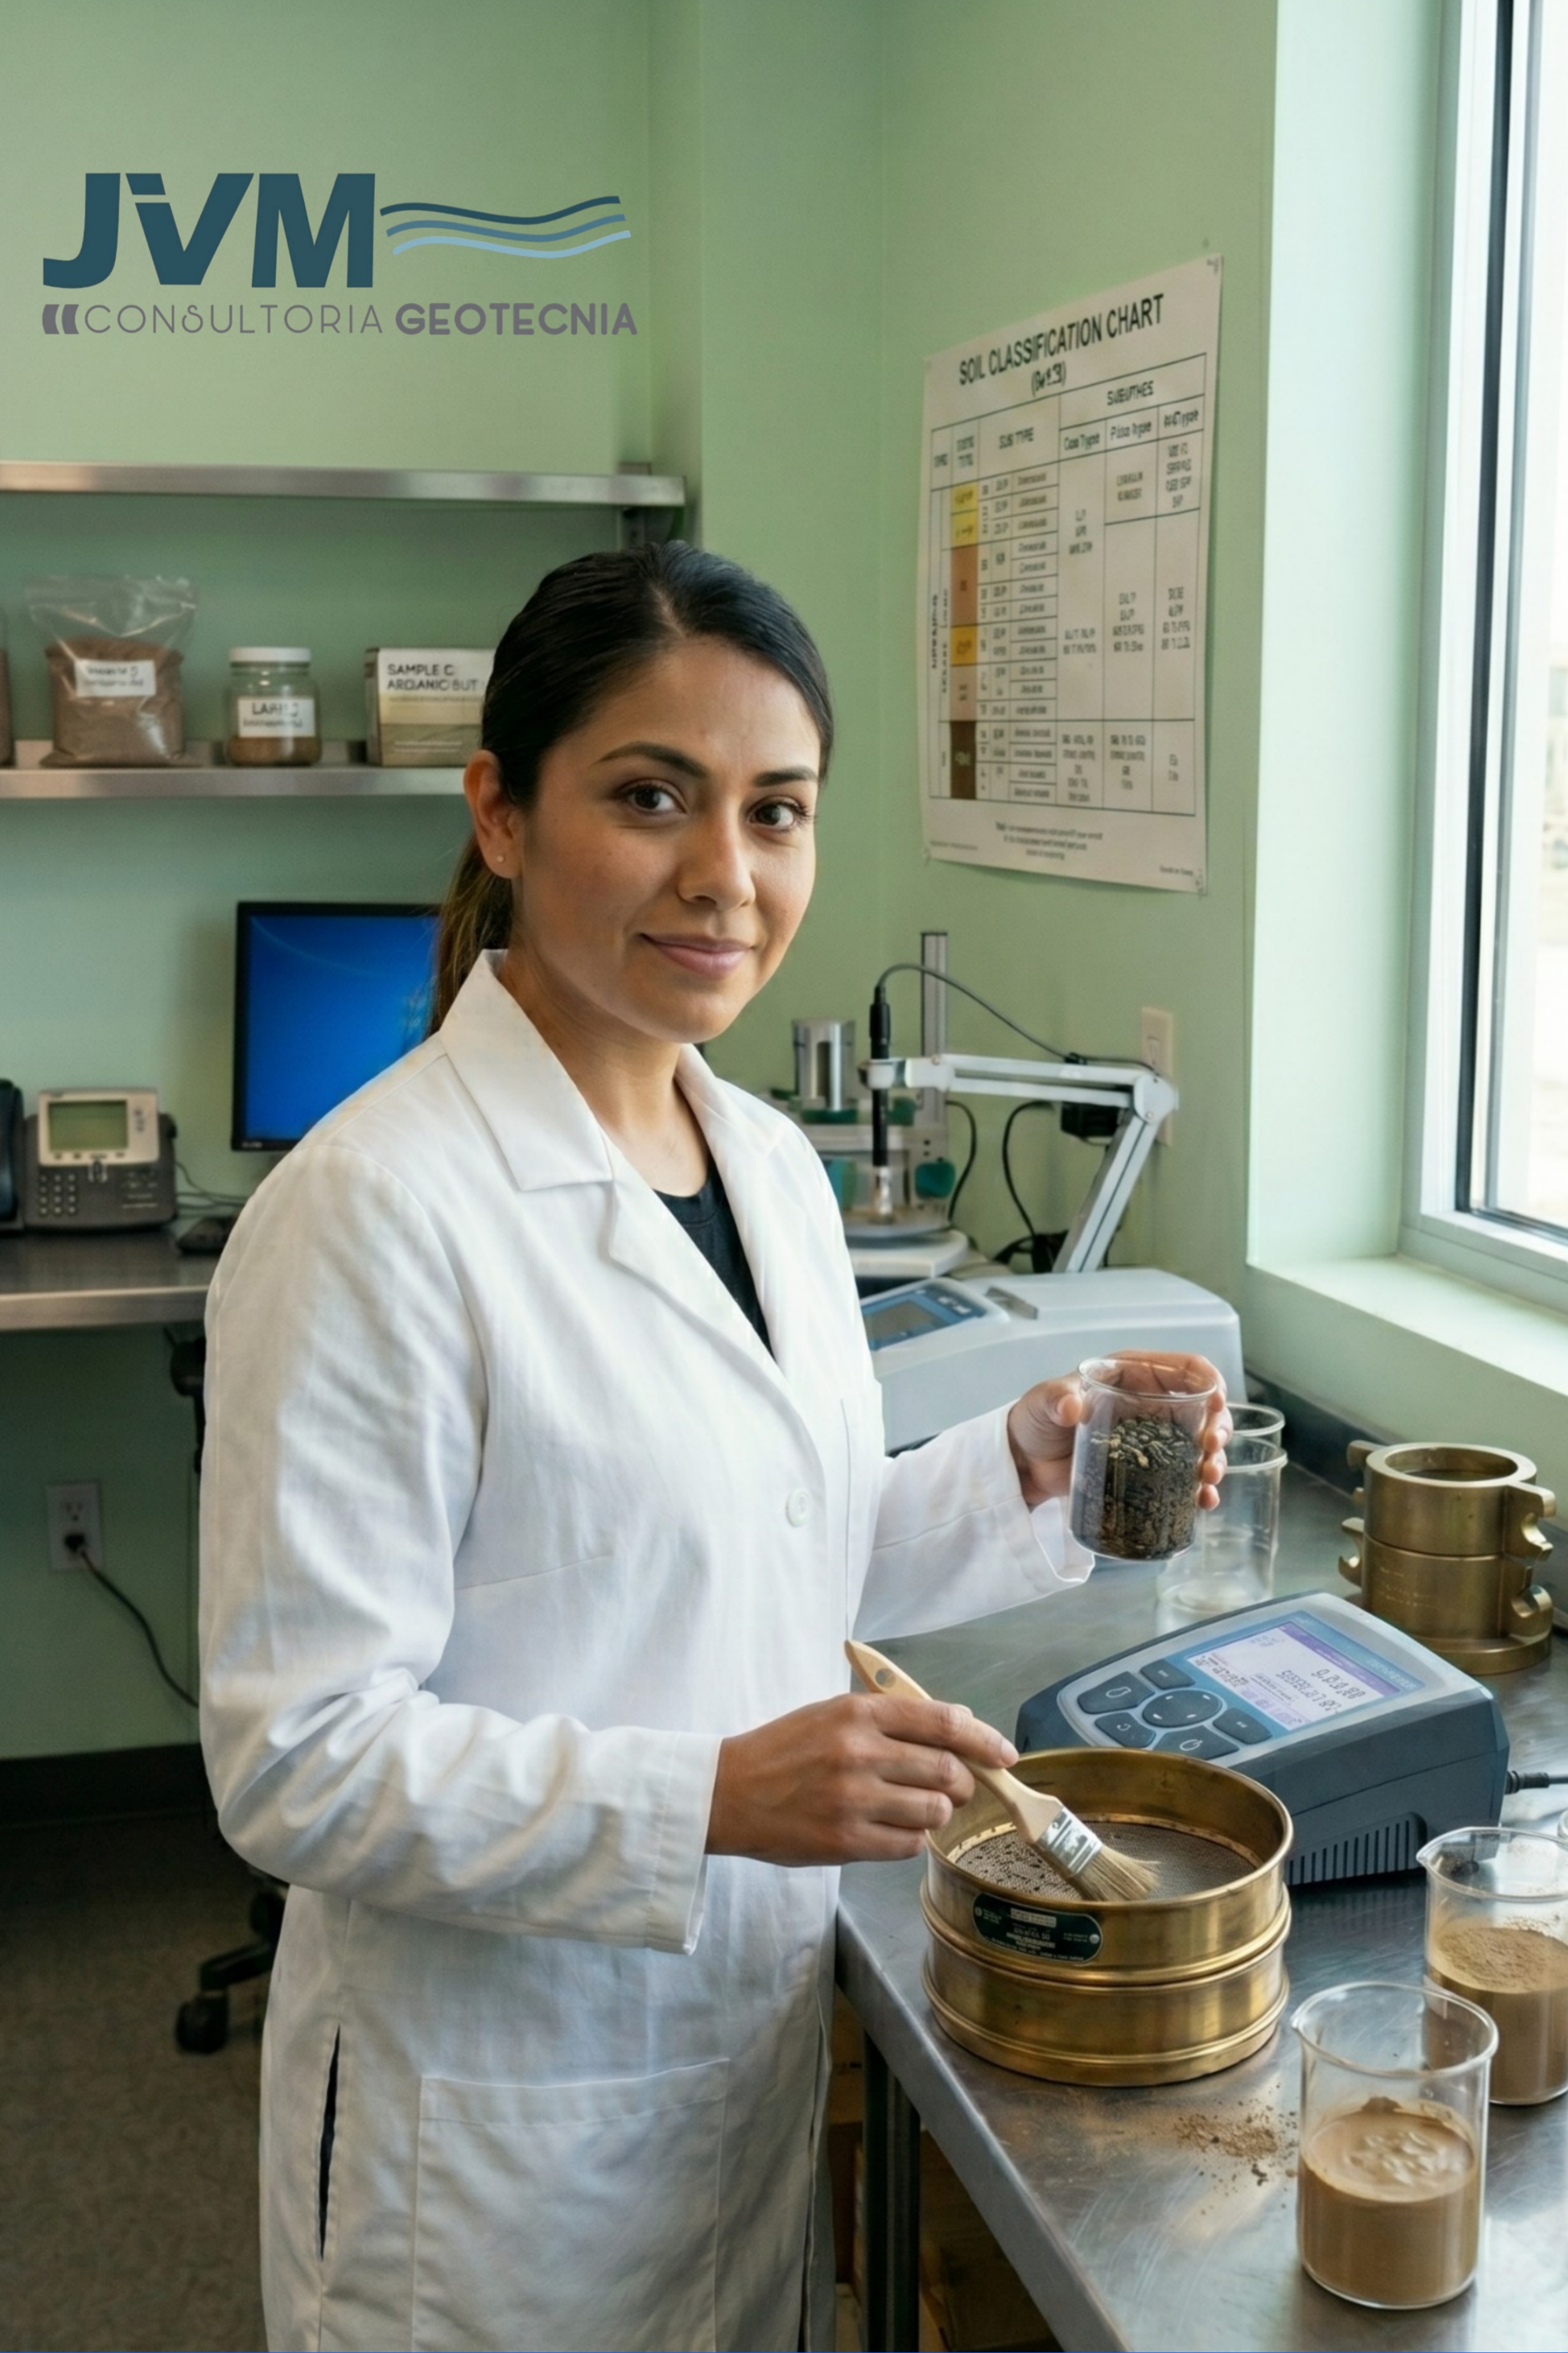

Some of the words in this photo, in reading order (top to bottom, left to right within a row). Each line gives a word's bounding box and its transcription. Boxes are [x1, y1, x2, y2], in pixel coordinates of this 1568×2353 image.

[959, 355, 986, 386] SOIL
[989, 313, 1102, 376] CLASSIFICATION
[1107, 293, 1164, 338] CHART
[388, 664, 440, 676] SAMPLE
